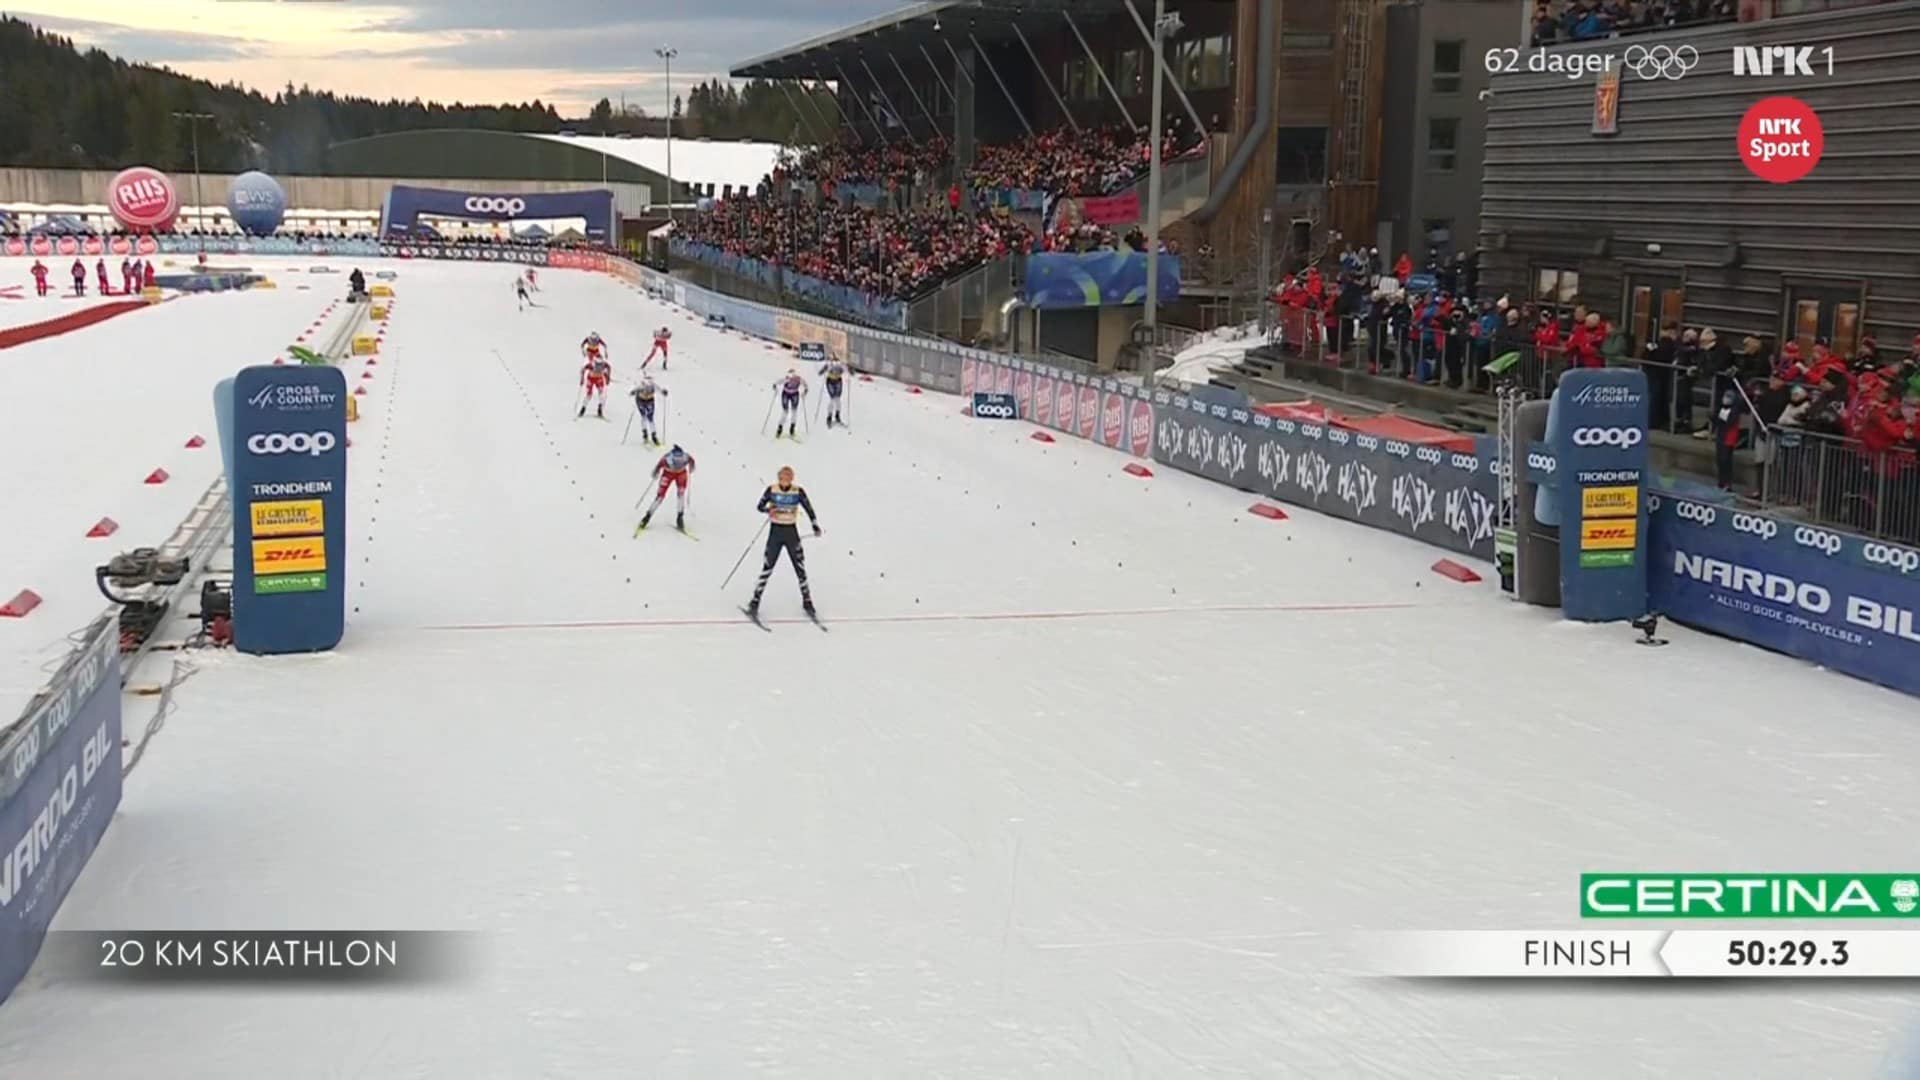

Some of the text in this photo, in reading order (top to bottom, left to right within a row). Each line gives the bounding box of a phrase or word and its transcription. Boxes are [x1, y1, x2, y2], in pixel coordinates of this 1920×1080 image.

[118, 178, 166, 204] RIIS
[465, 196, 526, 215] coop
[277, 385, 320, 395] CROSS
[277, 393, 335, 404] COUNTRY
[977, 404, 1014, 419] coop
[1277, 419, 1295, 435] coop
[1302, 424, 1322, 440] coop
[248, 431, 335, 456] coop
[1328, 429, 1350, 446] coop
[1356, 433, 1378, 451] coop
[1573, 427, 1641, 449] coop
[1386, 440, 1410, 458] coop
[1416, 446, 1441, 465] coop
[1452, 453, 1479, 472] coop
[1528, 453, 1556, 473] coop
[1577, 471, 1640, 483] TRONDHEIM
[253, 481, 332, 496] TRONDHEIM
[1676, 501, 1716, 527] coop
[1732, 513, 1777, 540] coop
[1794, 527, 1841, 556] coop
[264, 548, 316, 562] DHL
[1863, 543, 1919, 574] coop
[1674, 550, 1920, 643] NARDO BIL
[1785, 613, 1863, 645] OPPLEVELSER
[82, 719, 113, 788] BIL
